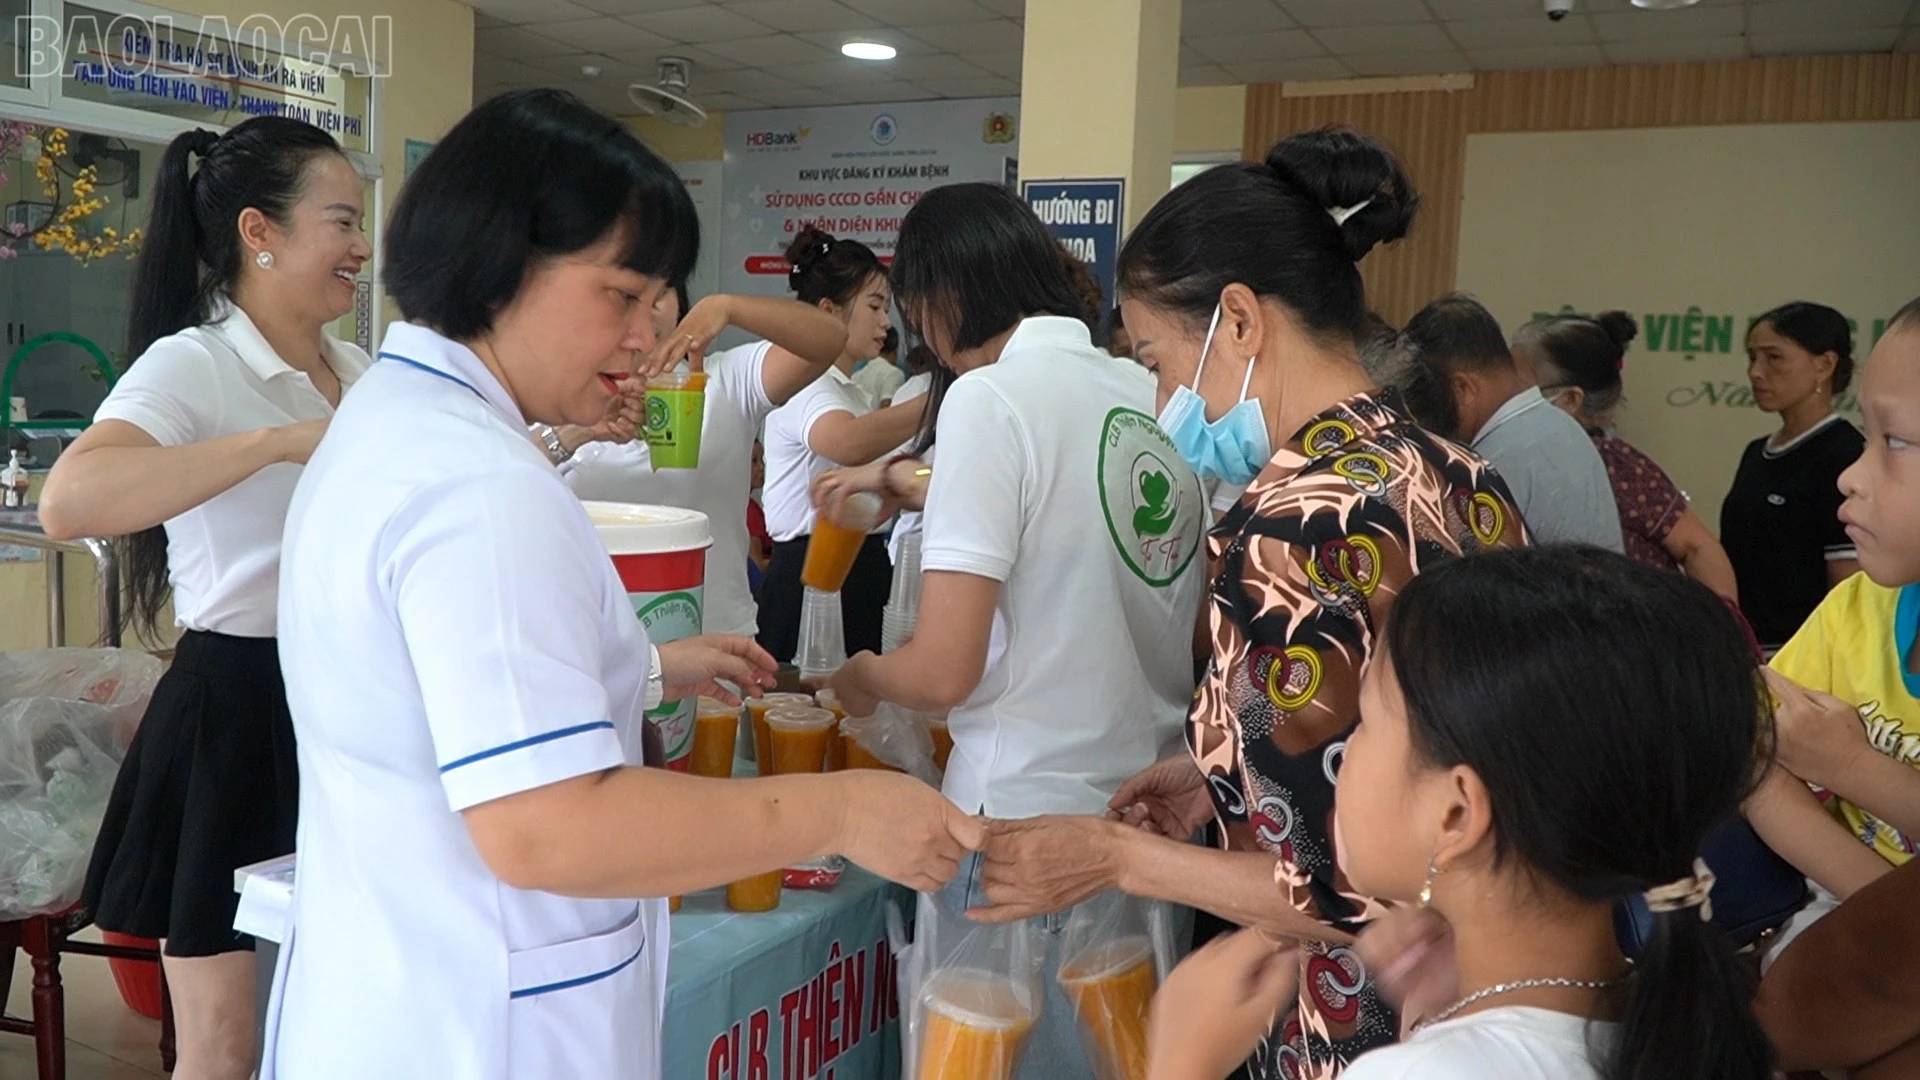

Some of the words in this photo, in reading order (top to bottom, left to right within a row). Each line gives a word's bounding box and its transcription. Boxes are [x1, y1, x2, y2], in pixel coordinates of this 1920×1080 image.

[158, 39, 183, 63] TRA
[263, 59, 278, 84] ÁN
[300, 69, 325, 97] VIỆN
[172, 77, 197, 104] VÀO
[201, 84, 229, 112] VIỆN
[316, 108, 341, 136] VIỆN
[746, 130, 798, 147] HDBank
[799, 169, 820, 182] KHU
[821, 166, 842, 182] VỰC
[842, 165, 871, 180] ĐĂNG
[872, 164, 886, 179] KÝ
[887, 164, 917, 178] KHÁM
[919, 162, 949, 181] BỆNH
[785, 192, 825, 210] DỤNG
[828, 192, 861, 207] CCCD
[1032, 190, 1092, 225] HƯỚNG
[1094, 199, 1115, 225] ĐI
[839, 214, 872, 235] DIỆN
[1643, 305, 1735, 361] VIỆN
